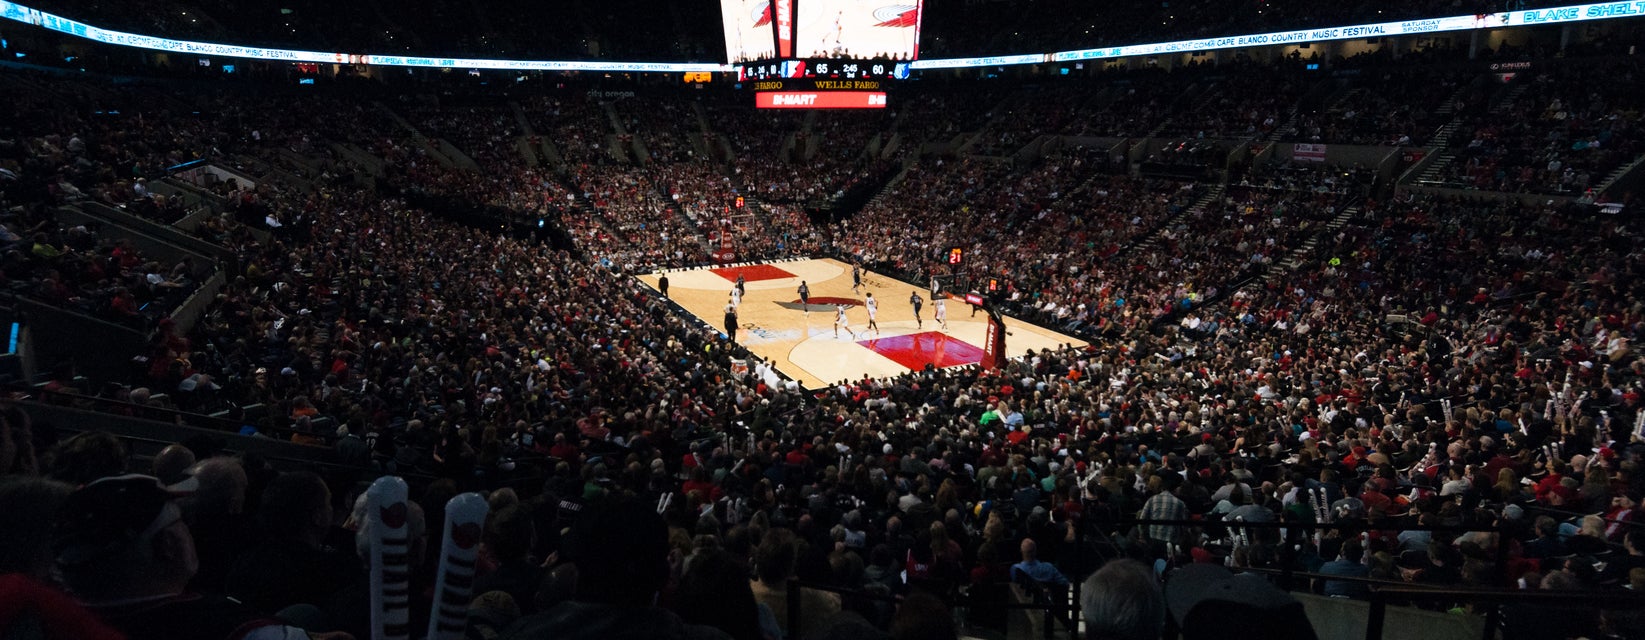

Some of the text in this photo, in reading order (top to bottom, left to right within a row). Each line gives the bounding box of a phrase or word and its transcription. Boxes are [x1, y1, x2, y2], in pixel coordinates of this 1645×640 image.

[1523, 7, 1580, 23] BLAKE
[1401, 19, 1441, 27] SATURDAY
[1217, 38, 1235, 47] CAPE
[1238, 35, 1268, 45] BLANCO
[1271, 32, 1309, 42] COUNTRY
[1311, 29, 1338, 39] MUSIC
[1342, 26, 1386, 37] FESTIVAL
[186, 43, 213, 53] BLANCO
[215, 46, 243, 54] COUNTRY
[245, 49, 264, 57] MUSIC
[266, 50, 298, 58] FESTIVAL
[816, 63, 828, 74] 65
[872, 64, 884, 75] 60
[760, 81, 783, 90] FARGO
[815, 81, 880, 89] WELLS FARGO
[772, 94, 817, 105] BI-MART
[949, 253, 961, 264] 21
